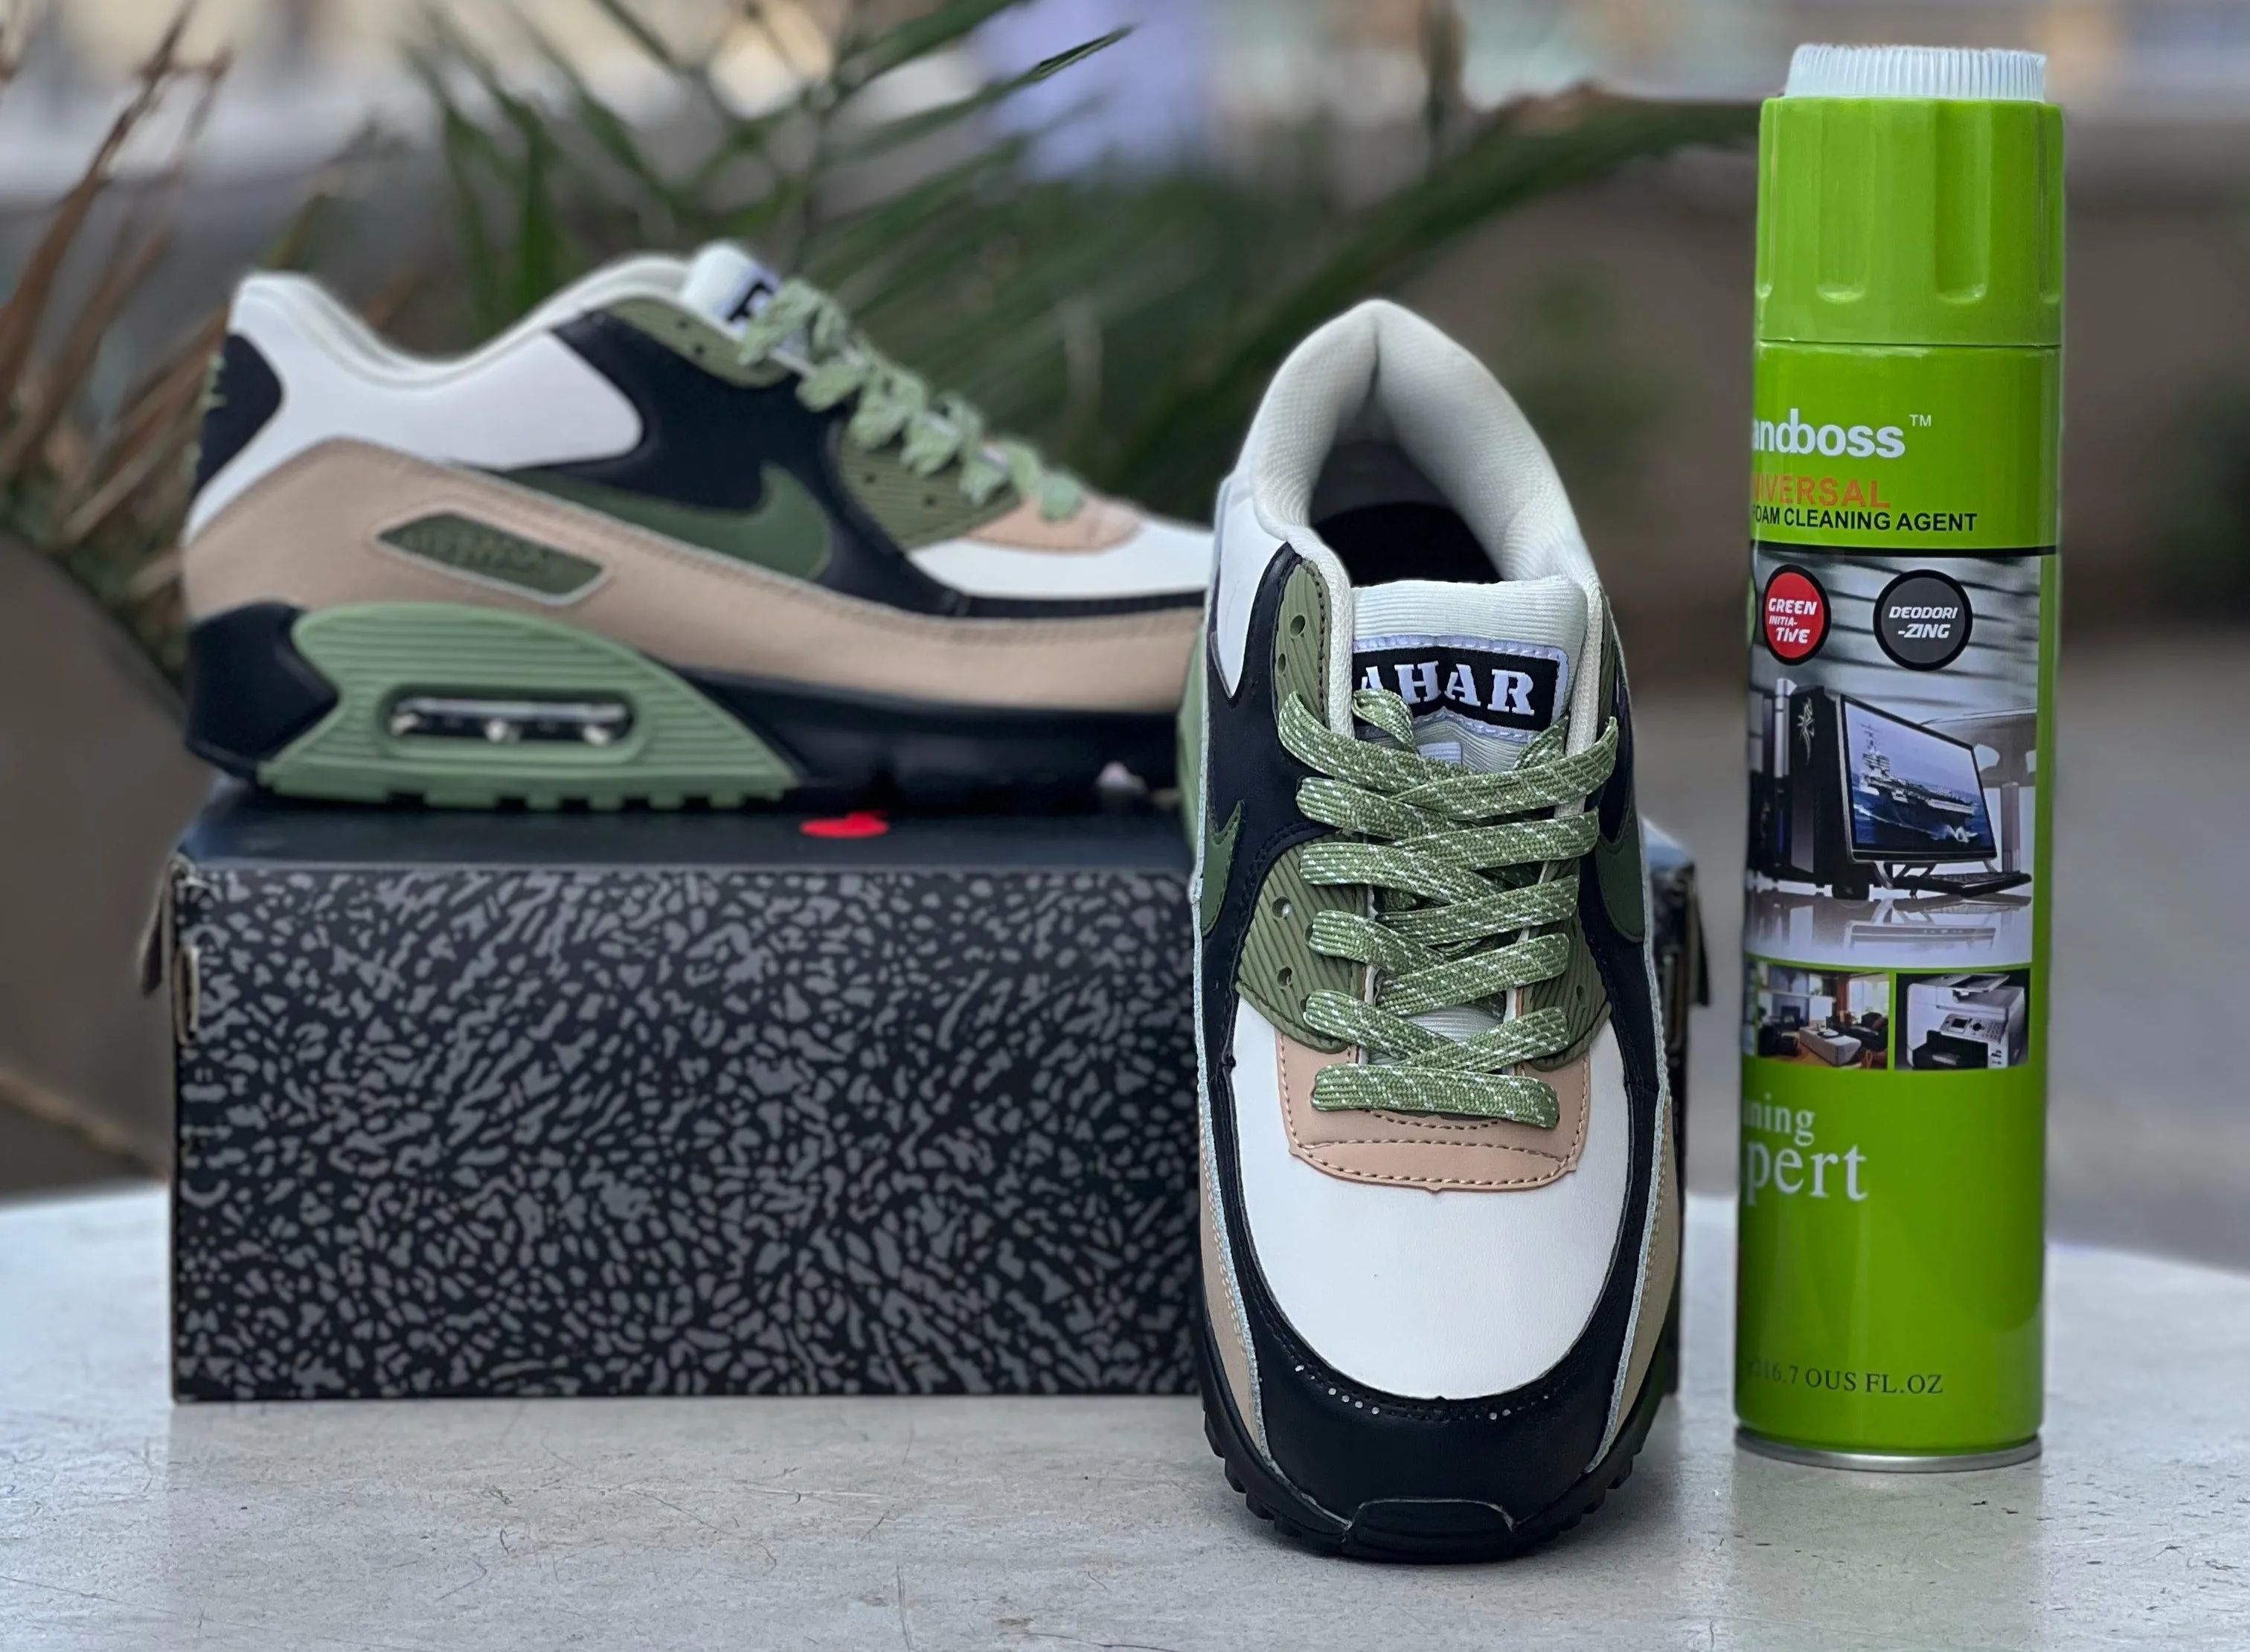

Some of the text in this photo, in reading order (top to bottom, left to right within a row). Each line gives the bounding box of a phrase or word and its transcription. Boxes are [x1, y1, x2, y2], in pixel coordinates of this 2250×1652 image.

[1909, 414, 1932, 427] TM
[1784, 508, 1891, 531] CLEANING
[1897, 513, 1978, 532] AGENT
[1768, 598, 1818, 615] GREEN
[1888, 606, 1958, 619] DEODORI
[1897, 623, 1951, 638] -ZING
[1747, 1143, 1868, 1207] pert
[1805, 1368, 1857, 1392] OUS
